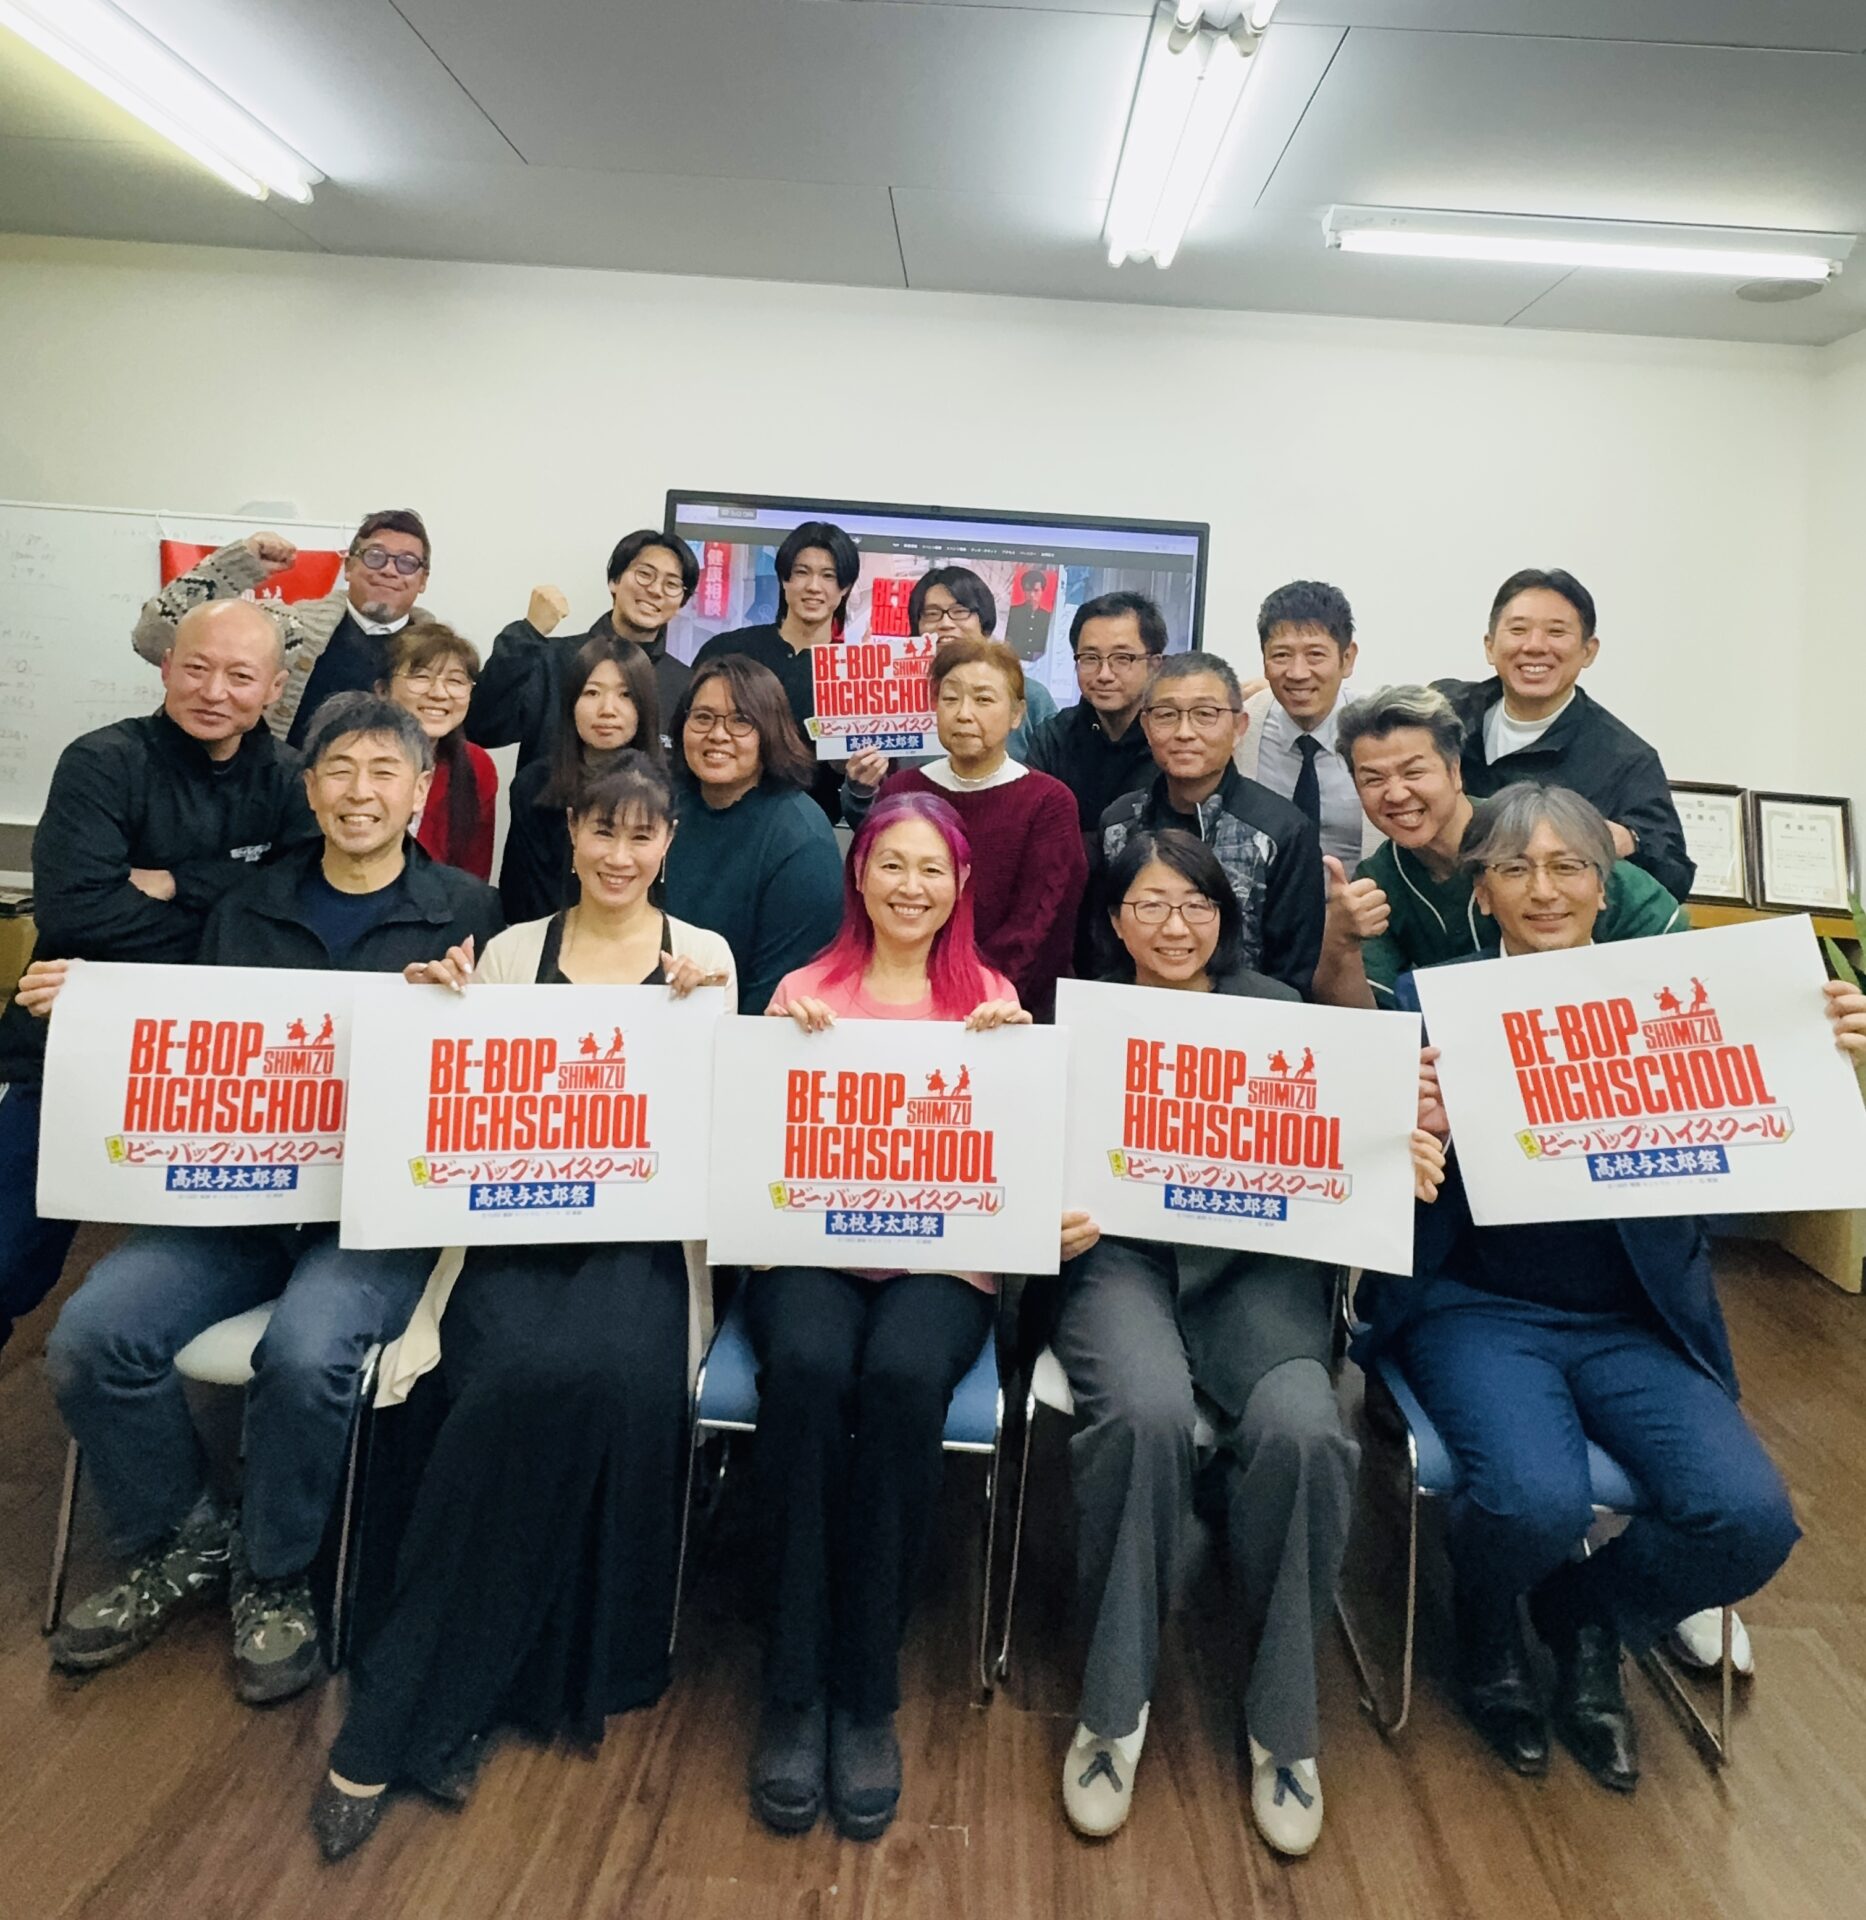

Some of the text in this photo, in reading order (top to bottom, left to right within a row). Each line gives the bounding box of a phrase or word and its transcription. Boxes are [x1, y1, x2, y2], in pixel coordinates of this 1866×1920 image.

[814, 644, 934, 680] BE-BOP SHIMIZ
[816, 678, 937, 717] HIGHSCHO
[129, 1018, 334, 1077] BE-BOP SHIMIZU
[1503, 997, 1724, 1068] BE-BOP SHIMIZU
[430, 1038, 626, 1095] BE-BOP SHIMIZU
[1125, 1037, 1317, 1111] BE-BOP SHIMIZU
[1515, 1044, 1776, 1125] HIGHSCHOOL
[426, 1093, 651, 1153] HIGHSCHOOL
[786, 1069, 972, 1127] BE-BOP SHIMIZU
[784, 1124, 998, 1184] HIGHSCHOOL
[1122, 1093, 1344, 1171] HIGHSCHOOL
[171, 1168, 293, 1190] 高校与太郎祭
[1594, 1150, 1722, 1179] 高校与太郎祭
[474, 1183, 591, 1209] 高校与太郎祭
[830, 1213, 940, 1235] 高校与太郎祭
[1169, 1187, 1283, 1219] 高校与太郎祭
